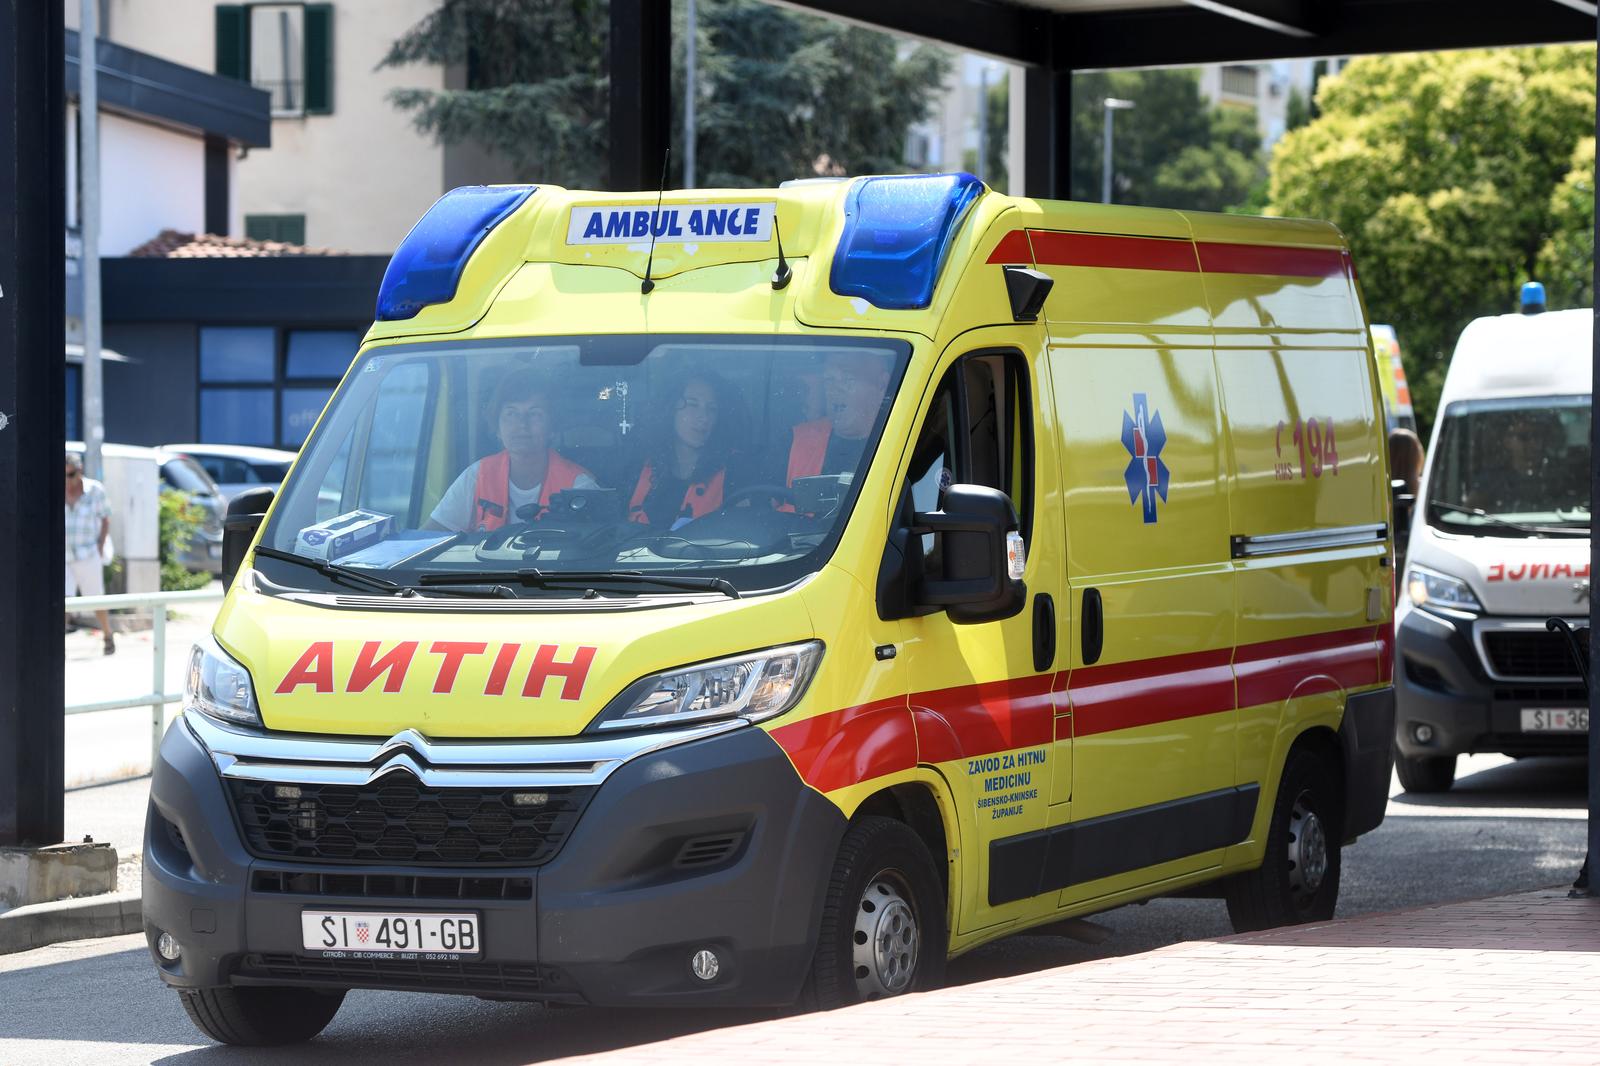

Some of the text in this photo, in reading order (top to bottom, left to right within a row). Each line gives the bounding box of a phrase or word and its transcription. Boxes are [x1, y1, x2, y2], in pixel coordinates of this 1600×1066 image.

[583, 208, 760, 238] AMBULANCE
[1293, 416, 1338, 478] 194
[968, 749, 1046, 775] ZAVOD ZA HITNU
[984, 771, 1031, 792] MEDICINU
[992, 804, 1023, 819] ŽUPANIJE
[375, 917, 475, 950] 491-GB
